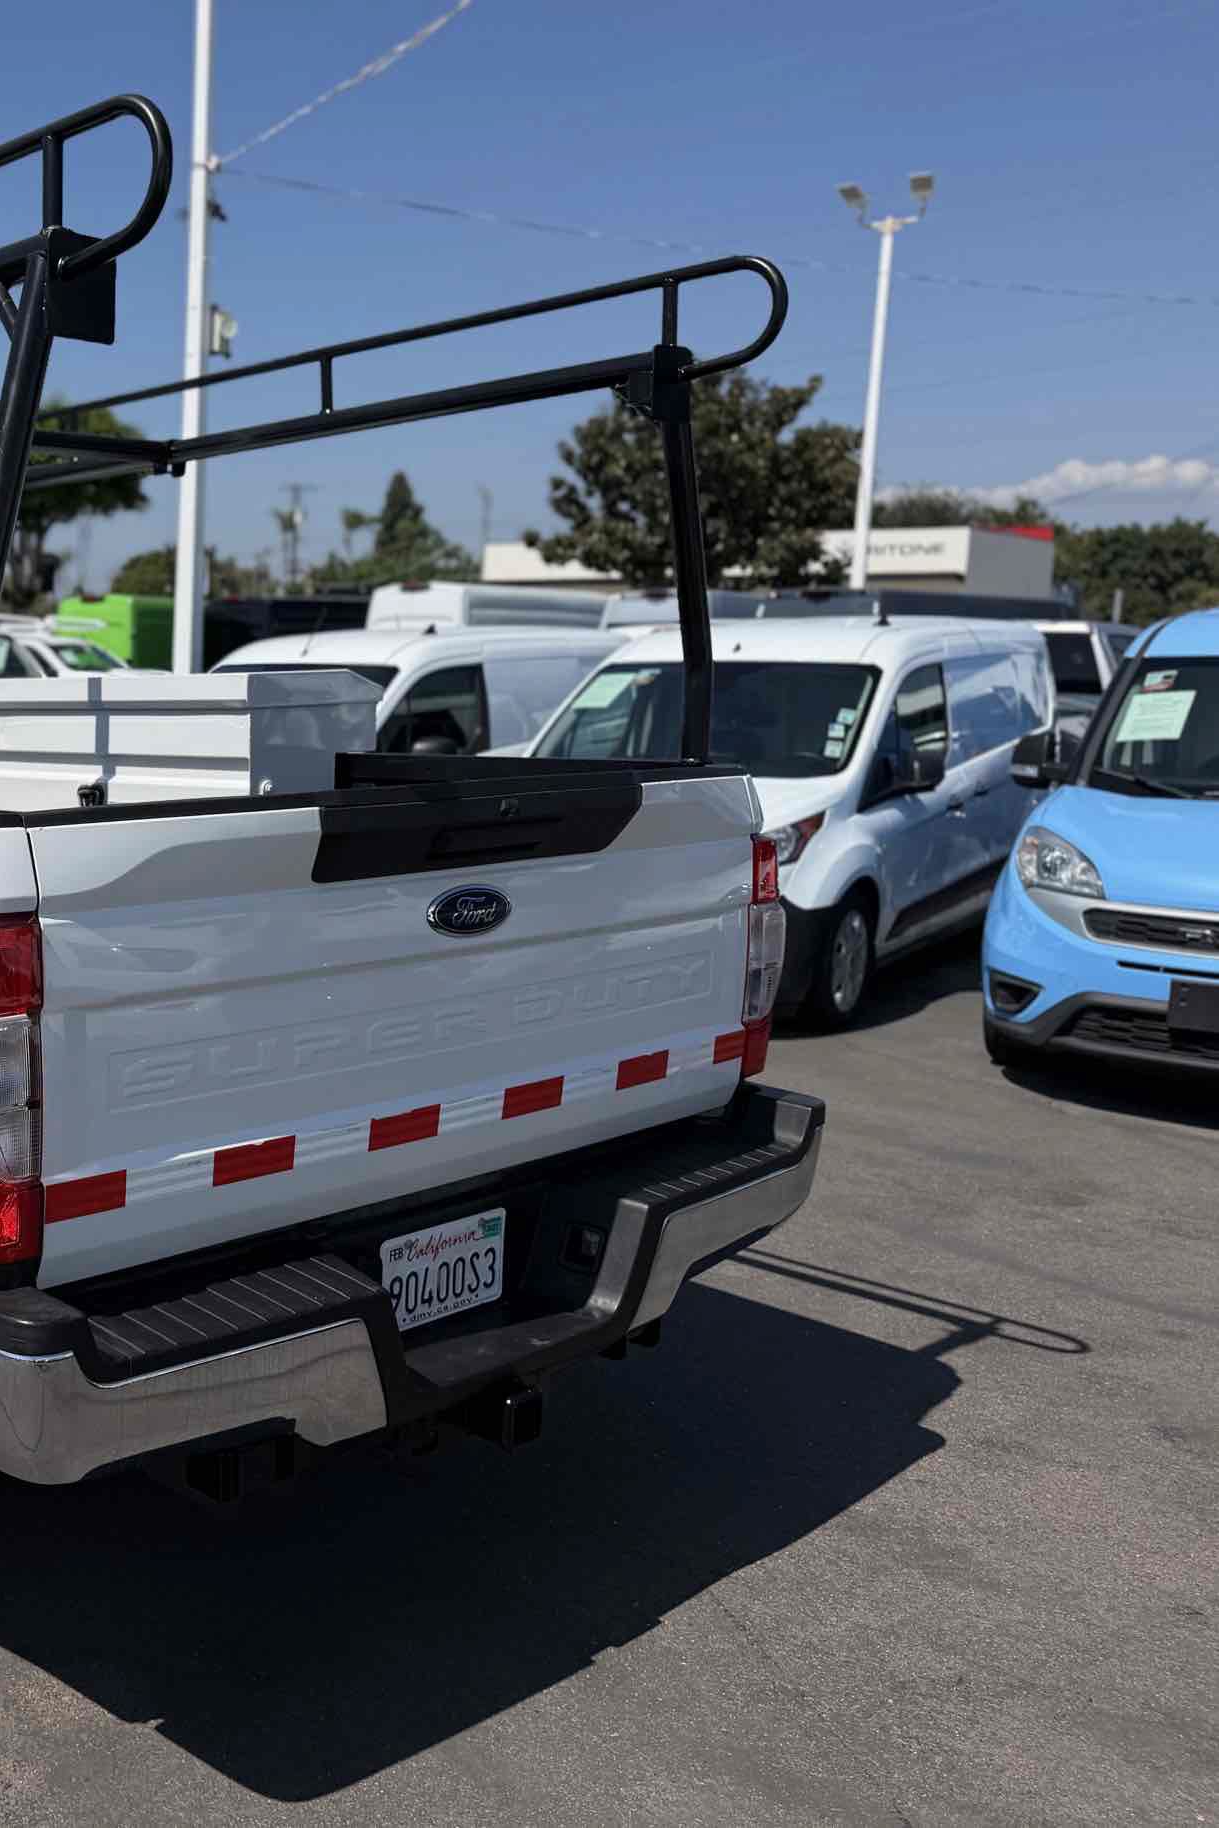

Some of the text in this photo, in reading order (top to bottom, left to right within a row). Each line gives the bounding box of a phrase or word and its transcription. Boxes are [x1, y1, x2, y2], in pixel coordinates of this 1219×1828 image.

[452, 896, 497, 925] Ford
[122, 959, 706, 1098] SUPER DUTY
[389, 1246, 404, 1263] FEB
[407, 1230, 484, 1262] California
